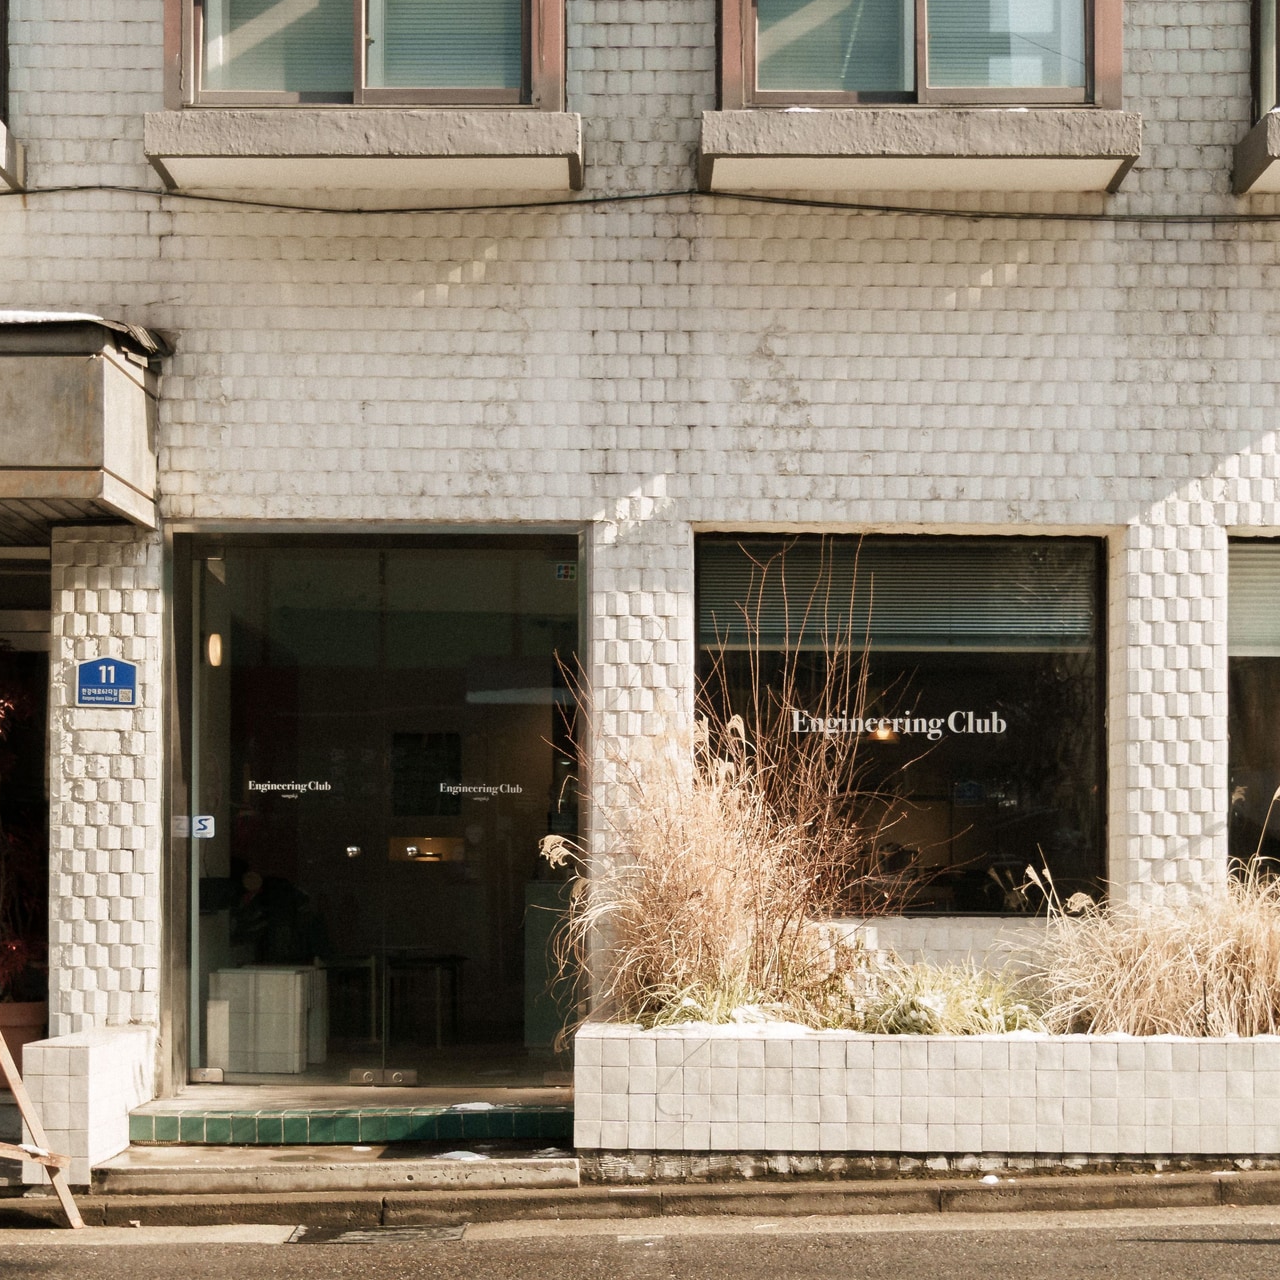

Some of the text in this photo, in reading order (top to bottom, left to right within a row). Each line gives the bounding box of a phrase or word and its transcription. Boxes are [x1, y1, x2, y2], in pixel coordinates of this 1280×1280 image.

[98, 665, 115, 684] 11
[791, 709, 1007, 741] Engineering Club
[248, 780, 332, 793] Engineering Club
[440, 782, 523, 796] Engineering Club
